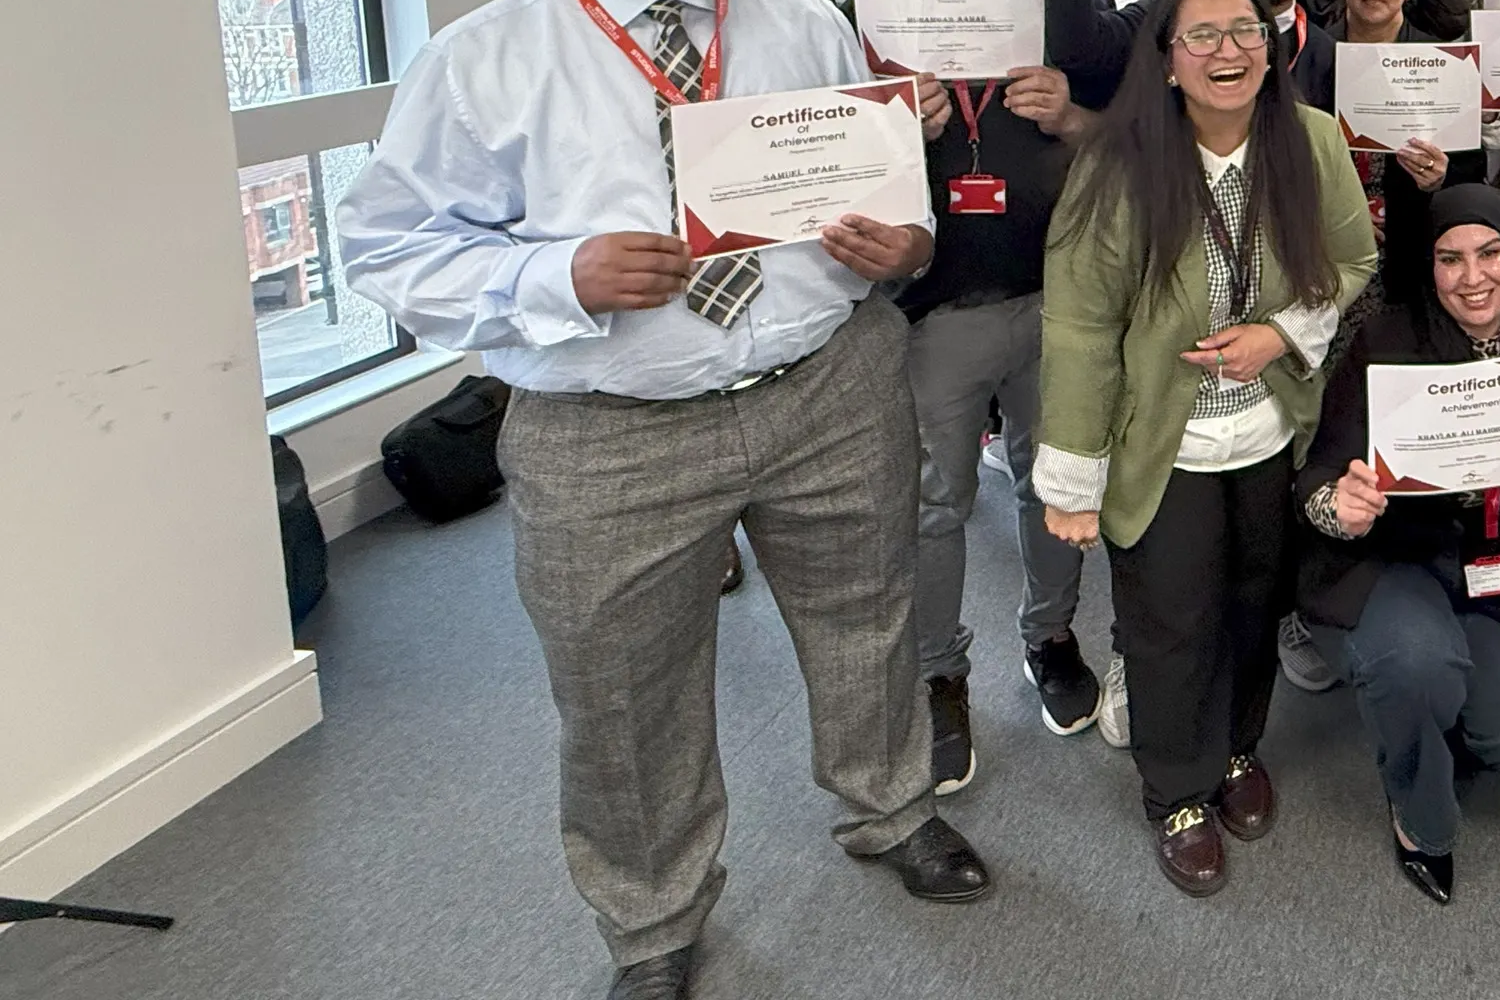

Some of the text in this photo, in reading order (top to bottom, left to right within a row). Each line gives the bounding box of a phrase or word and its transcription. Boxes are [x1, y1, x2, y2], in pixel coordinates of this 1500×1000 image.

[630, 49, 657, 78] STUDENT
[1382, 57, 1446, 68] Certificate
[751, 105, 857, 129] Certificate
[797, 124, 810, 134] Of
[769, 131, 847, 149] Achievement
[763, 168, 804, 182] SAMUEL
[1464, 393, 1474, 401] Of
